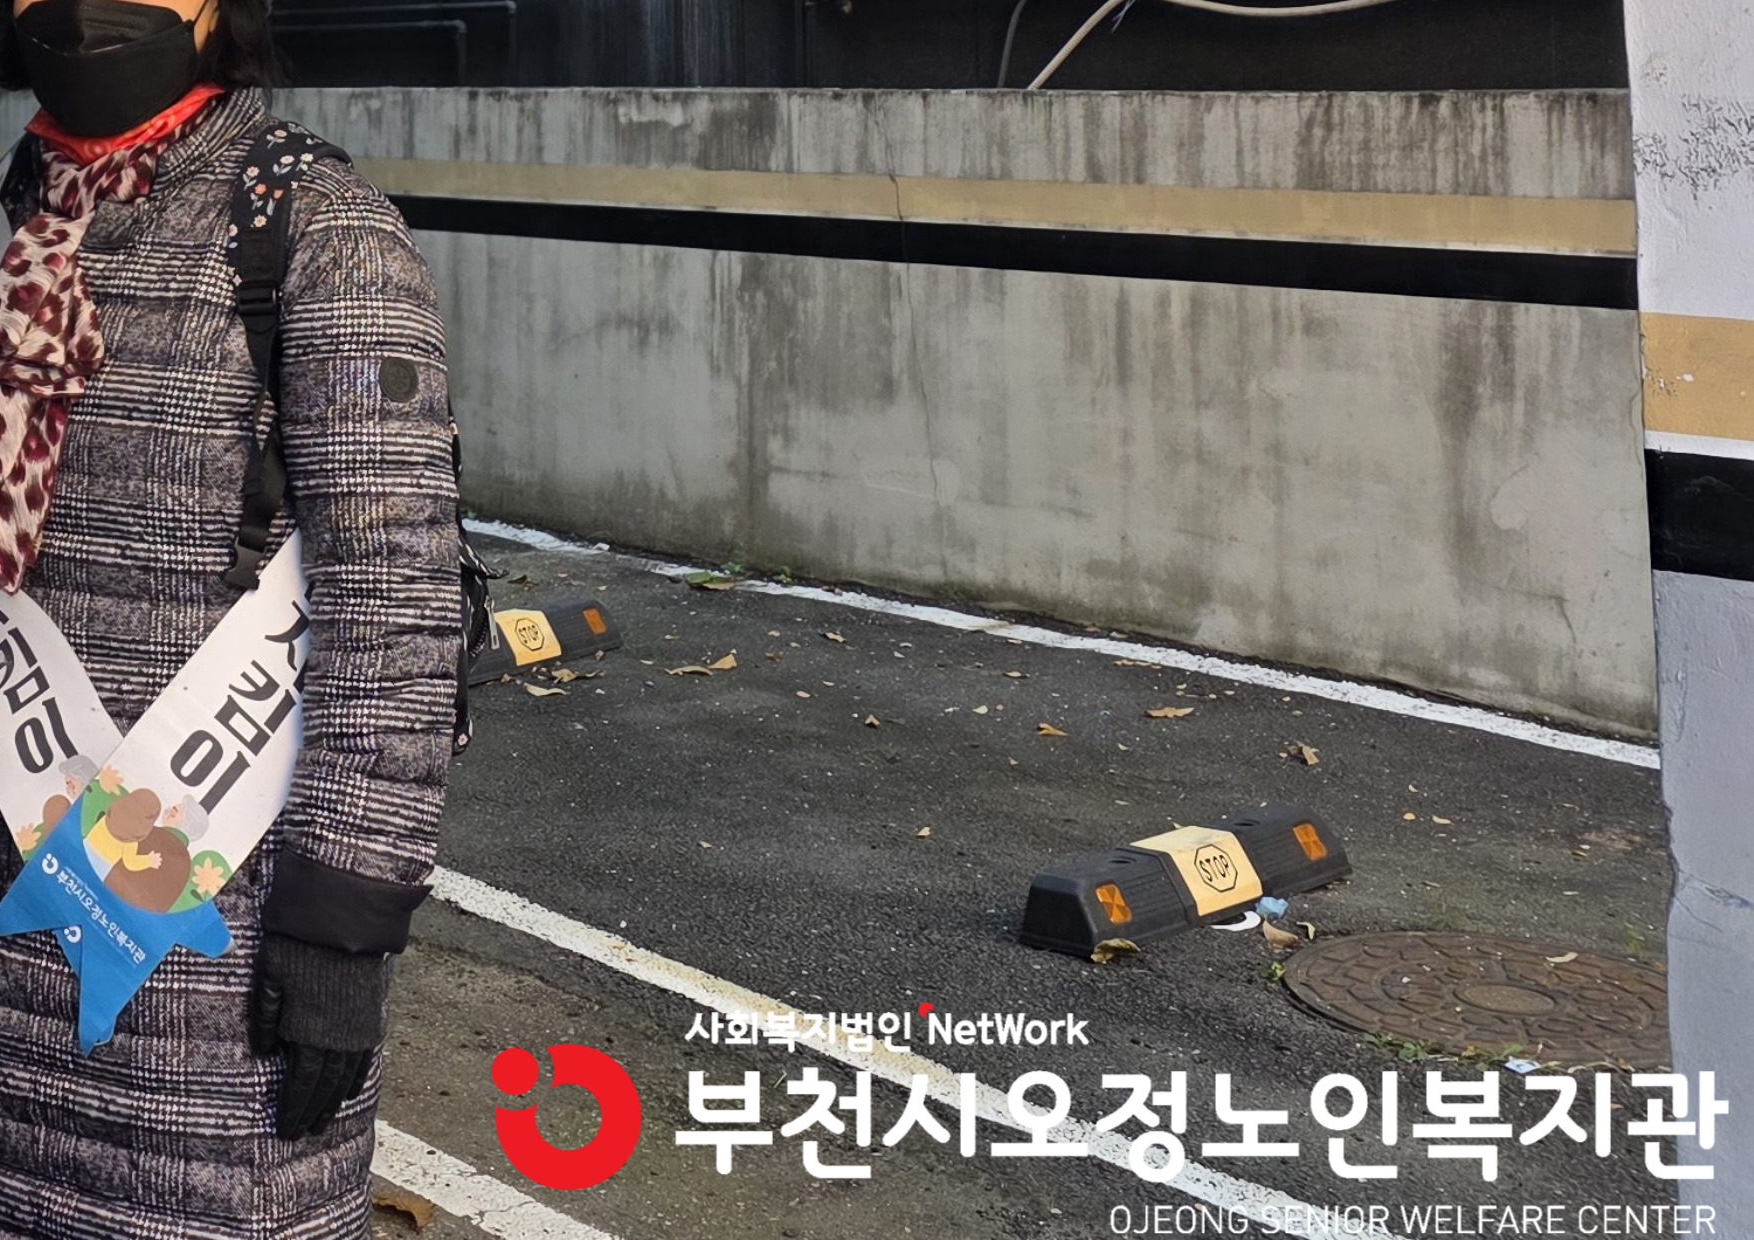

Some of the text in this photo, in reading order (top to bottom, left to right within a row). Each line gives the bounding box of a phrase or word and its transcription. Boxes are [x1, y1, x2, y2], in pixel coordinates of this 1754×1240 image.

[518, 624, 540, 644] STOP
[170, 582, 311, 815] 지킴이
[1199, 854, 1231, 883] STOP
[56, 869, 146, 965] 부천시오정노인복지관
